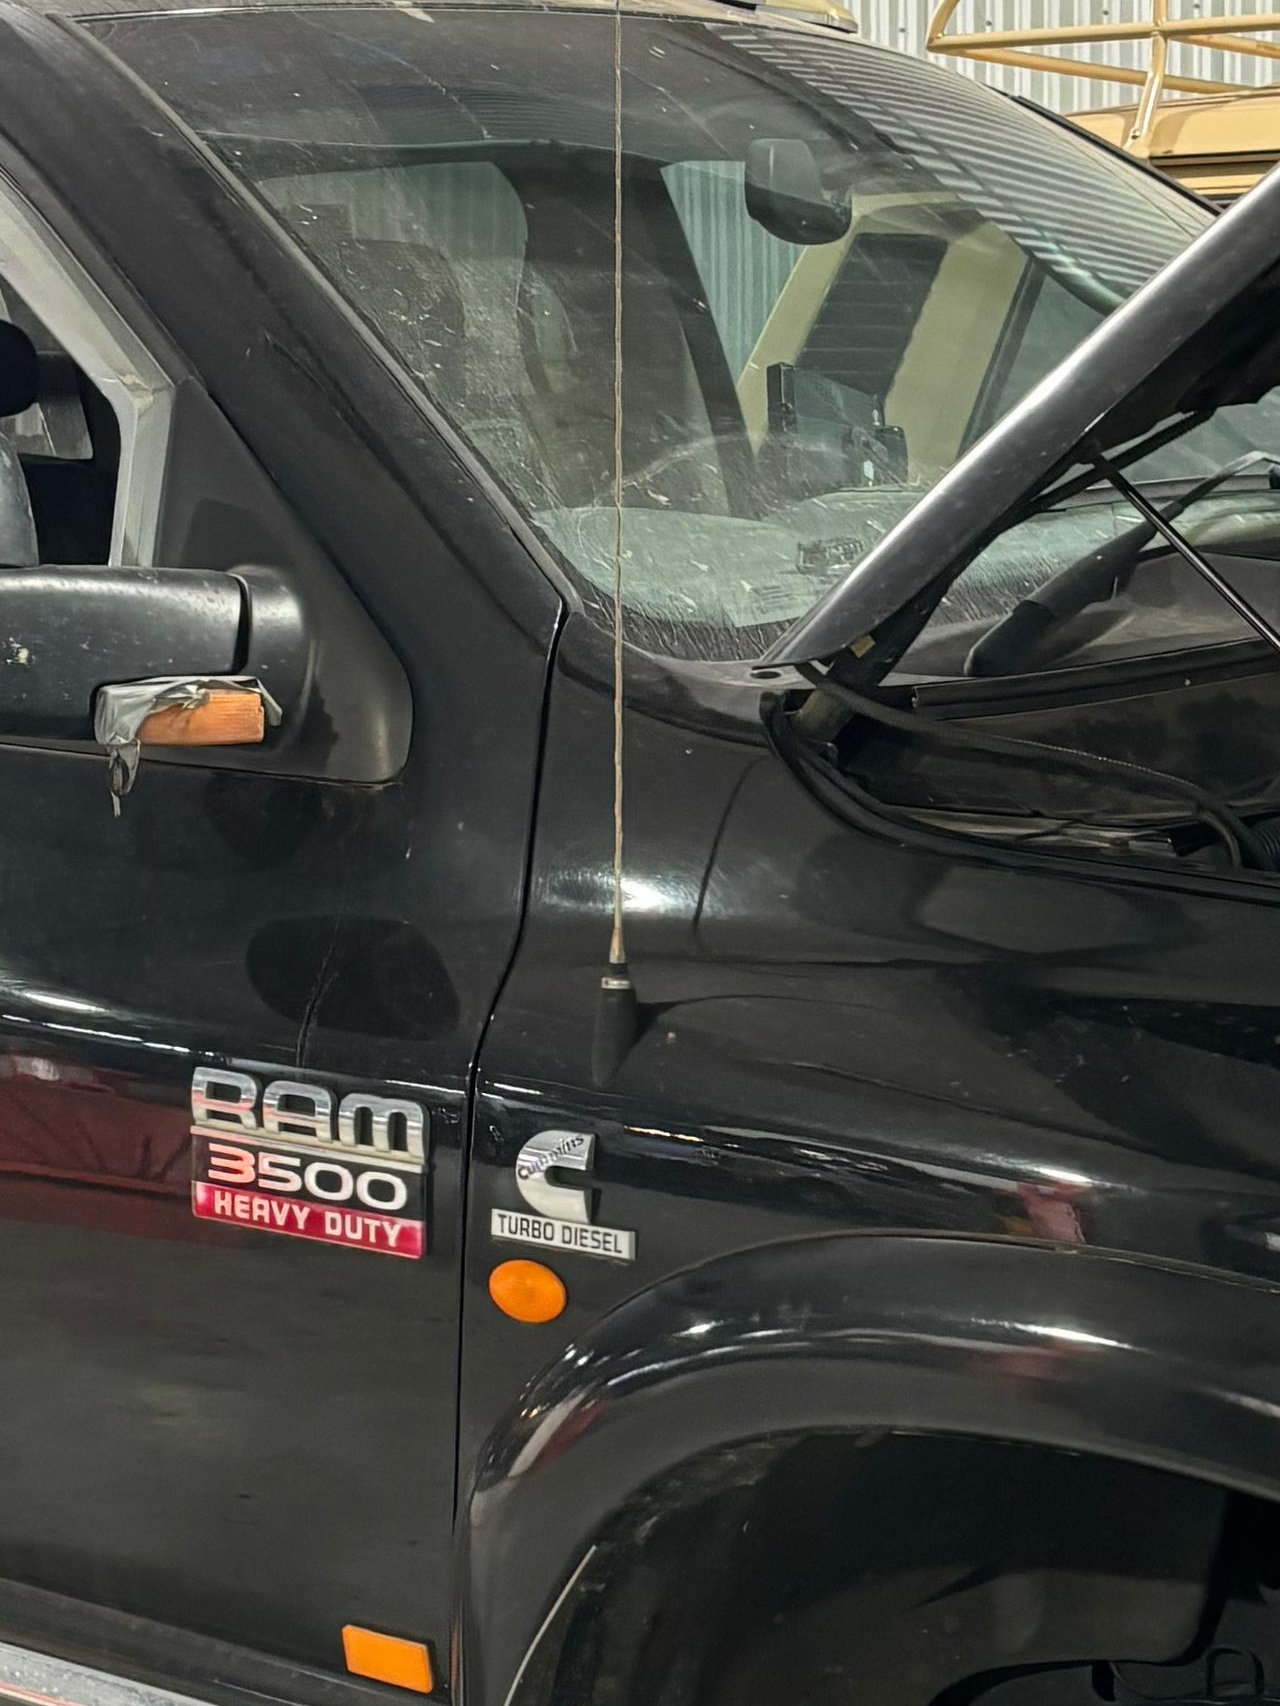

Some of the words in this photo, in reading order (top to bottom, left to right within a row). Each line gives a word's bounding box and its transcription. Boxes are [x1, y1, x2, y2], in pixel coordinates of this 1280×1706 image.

[192, 1067, 425, 1164] RAM
[208, 1143, 407, 1210] 3500
[214, 1190, 310, 1230] HEAVY
[324, 1211, 401, 1247] DUTY
[497, 1213, 555, 1241] TURBO
[561, 1225, 622, 1253] DIESEL
